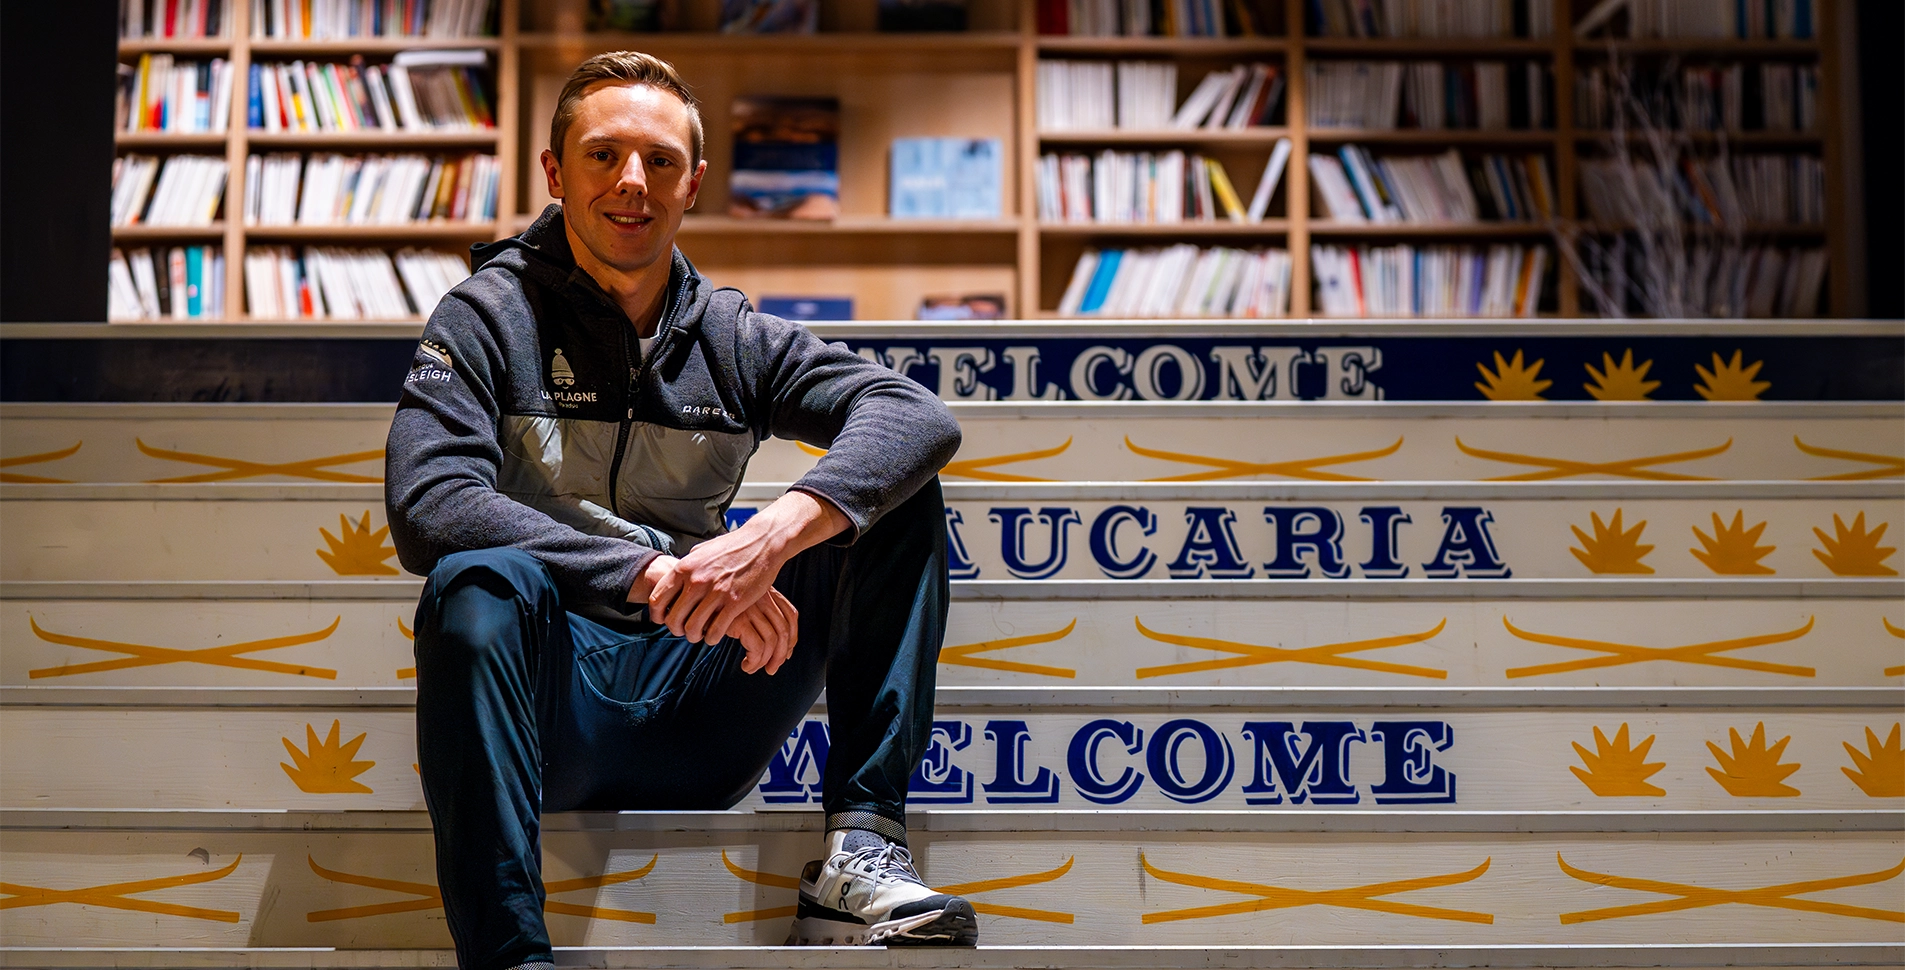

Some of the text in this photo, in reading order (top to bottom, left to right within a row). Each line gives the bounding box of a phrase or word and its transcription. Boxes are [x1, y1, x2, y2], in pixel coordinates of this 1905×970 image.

[406, 370, 452, 382] SLEIGH
[540, 390, 598, 402] LA PLAGNE
[725, 506, 1513, 579] UCARIA
